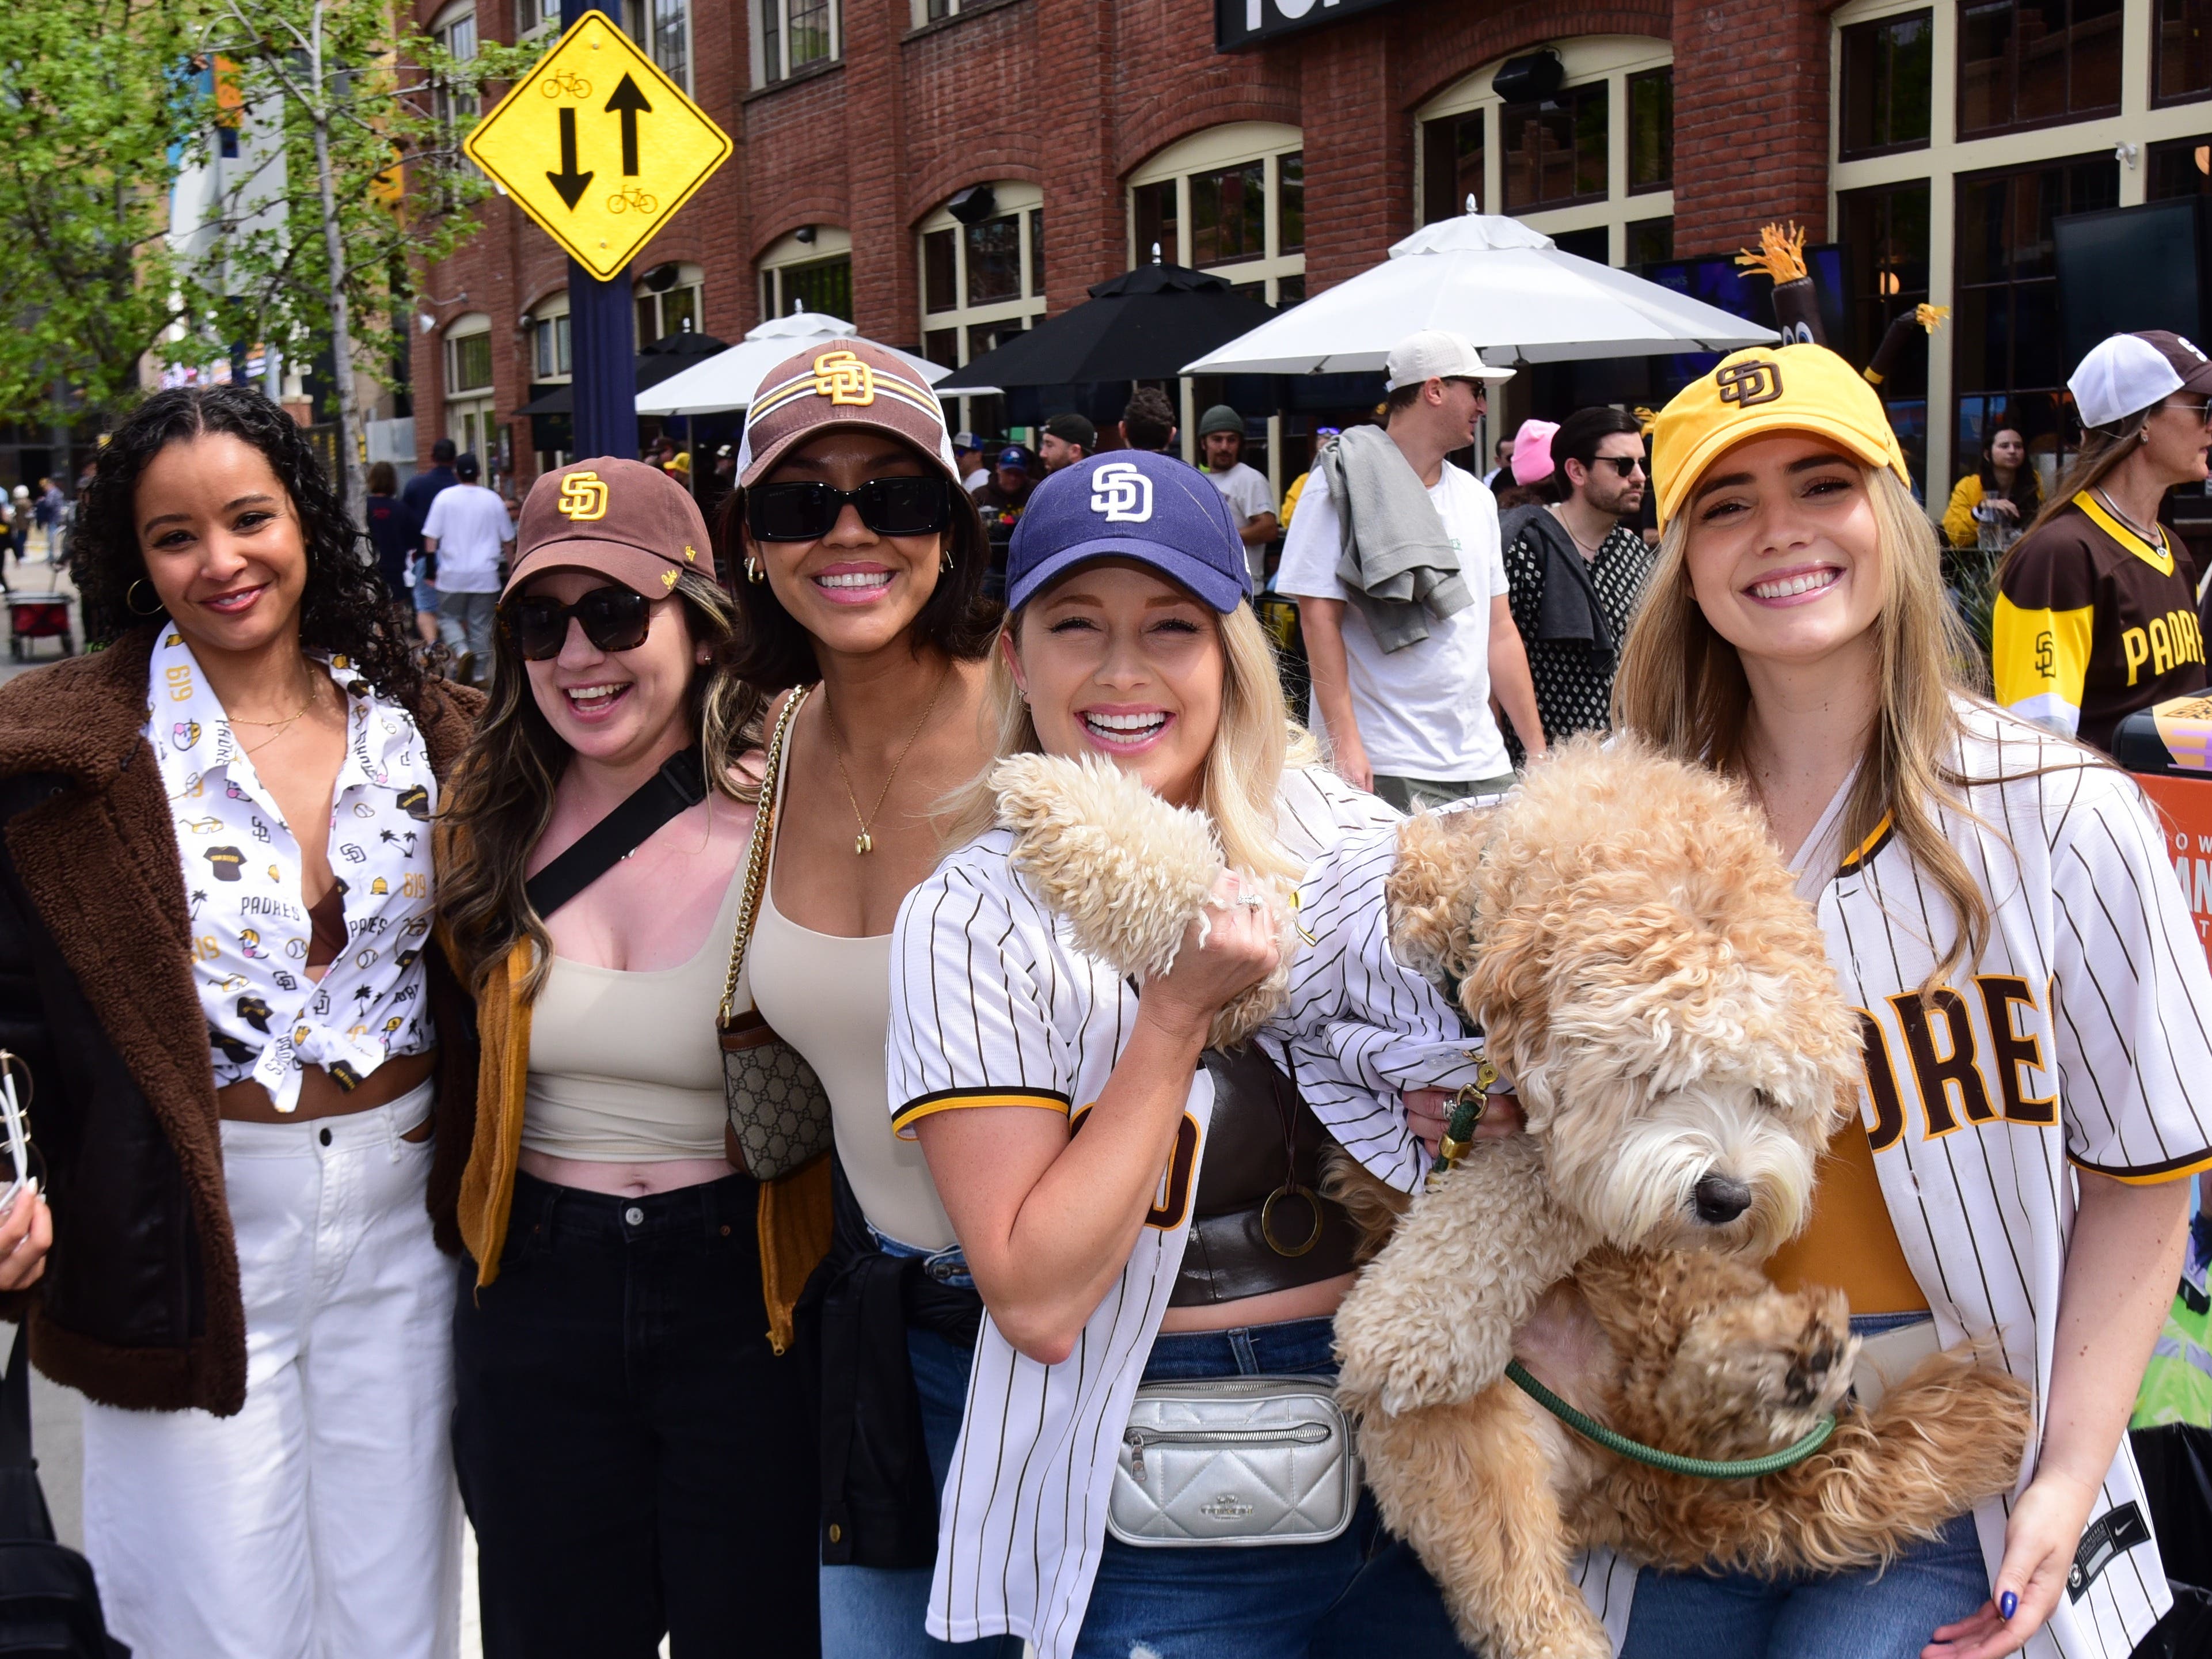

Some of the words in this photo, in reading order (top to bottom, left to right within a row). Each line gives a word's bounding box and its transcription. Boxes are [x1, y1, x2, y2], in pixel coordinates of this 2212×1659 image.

[814, 351, 874, 407] SD
[1716, 359, 1783, 409] SD
[558, 472, 608, 521] SD
[1091, 462, 1153, 523] SD
[165, 665, 193, 701] 619
[340, 843, 367, 863] SD
[240, 896, 300, 921] PADRES
